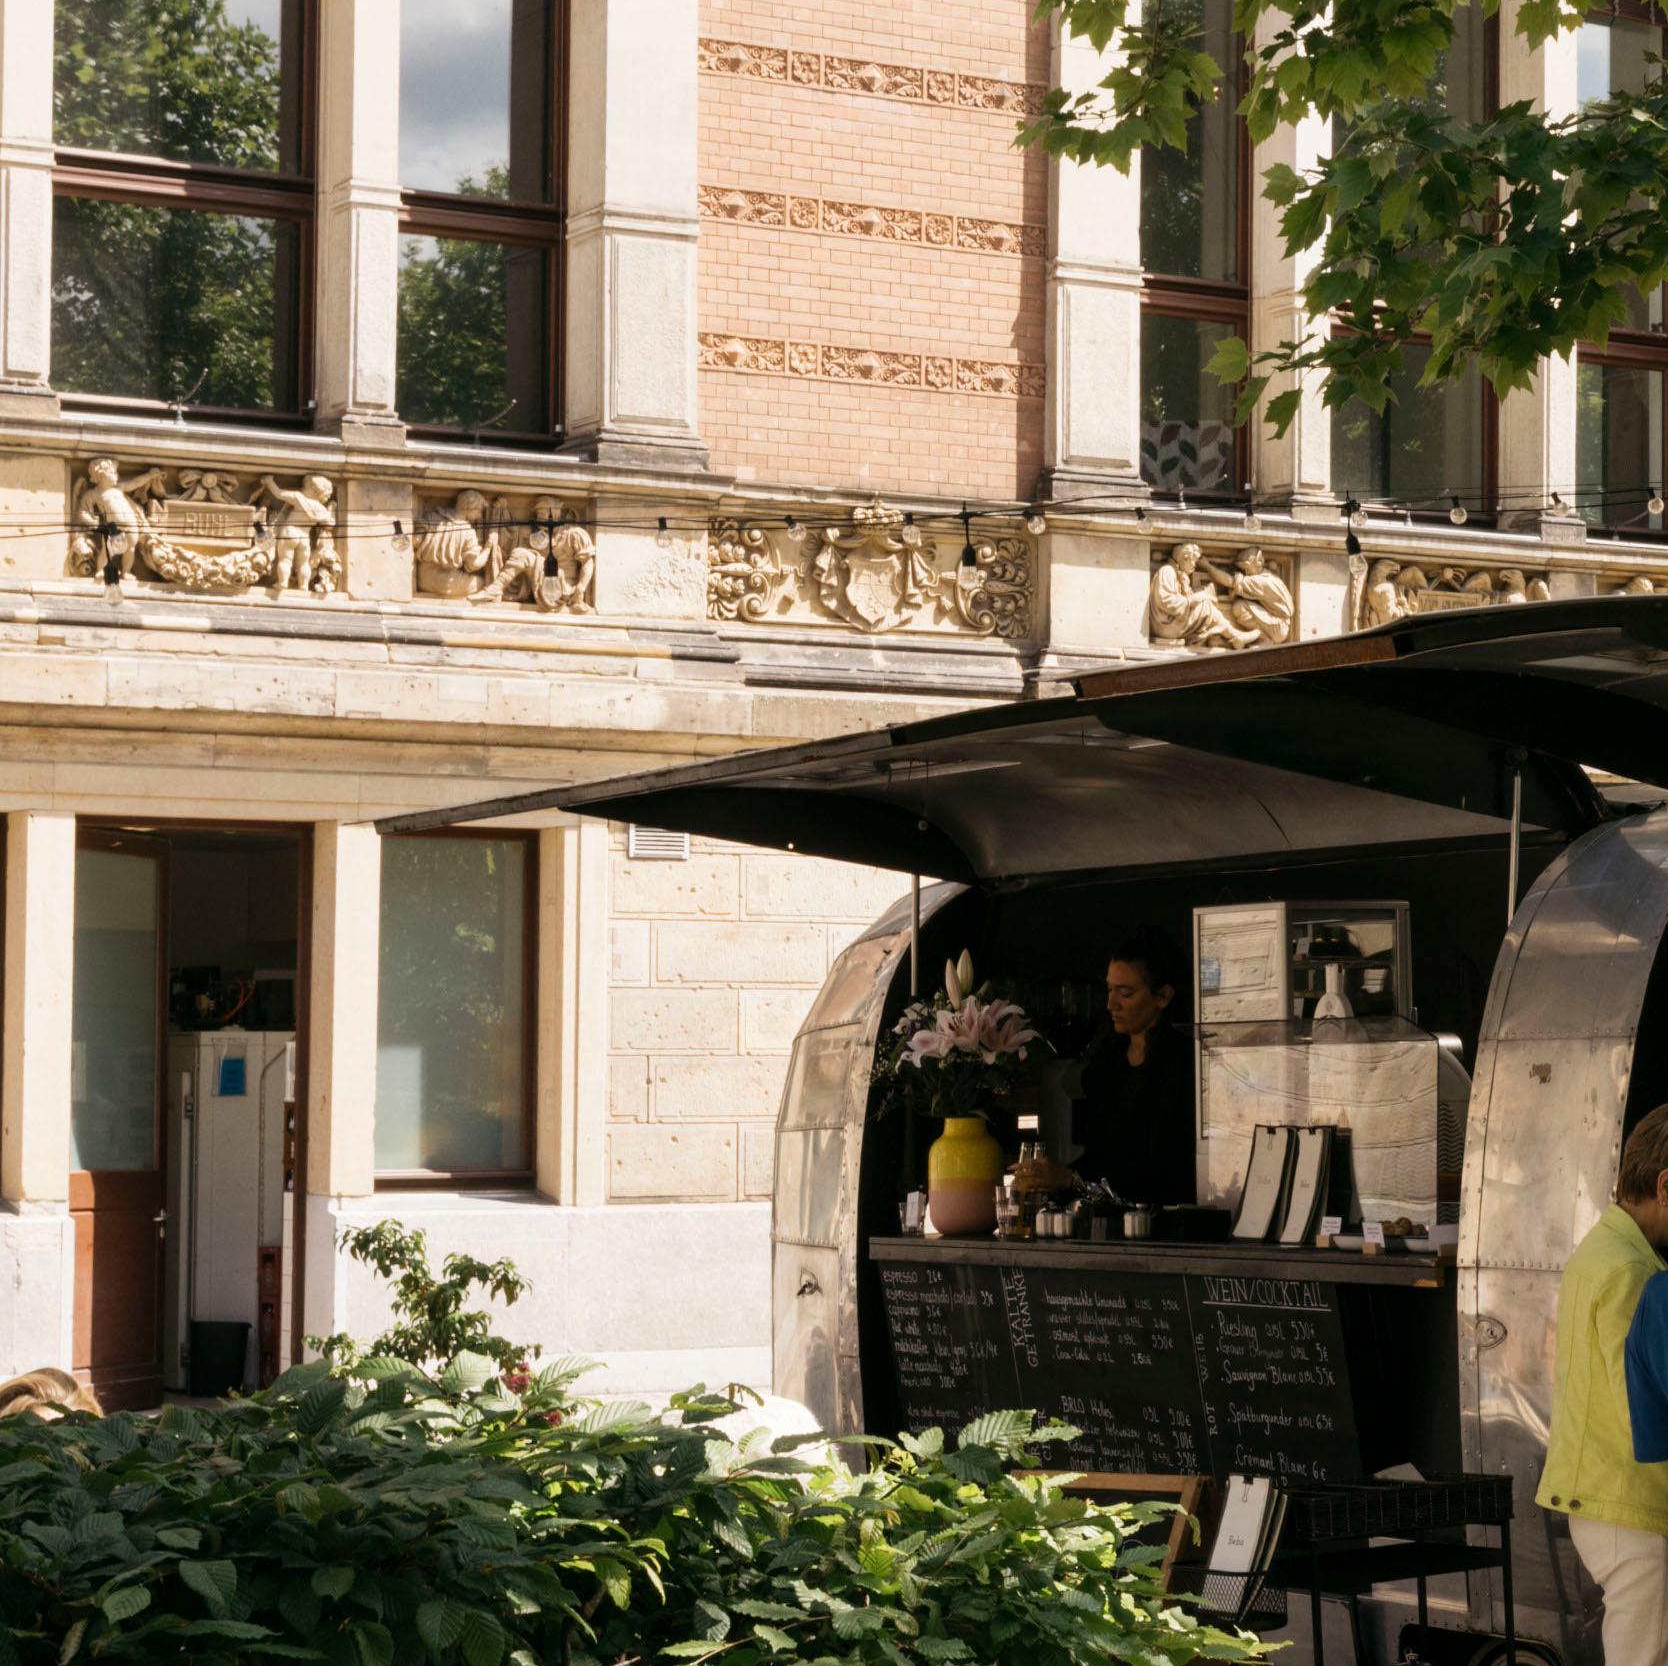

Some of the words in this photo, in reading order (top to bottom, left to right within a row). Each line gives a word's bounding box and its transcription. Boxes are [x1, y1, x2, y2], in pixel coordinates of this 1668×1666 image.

[1203, 1276, 1329, 1308] WEIN/COCKTAIL
[1223, 1359, 1268, 1392] Sauvignon
[1205, 1401, 1218, 1437] ROT
[1278, 1452, 1308, 1476] Blanc
